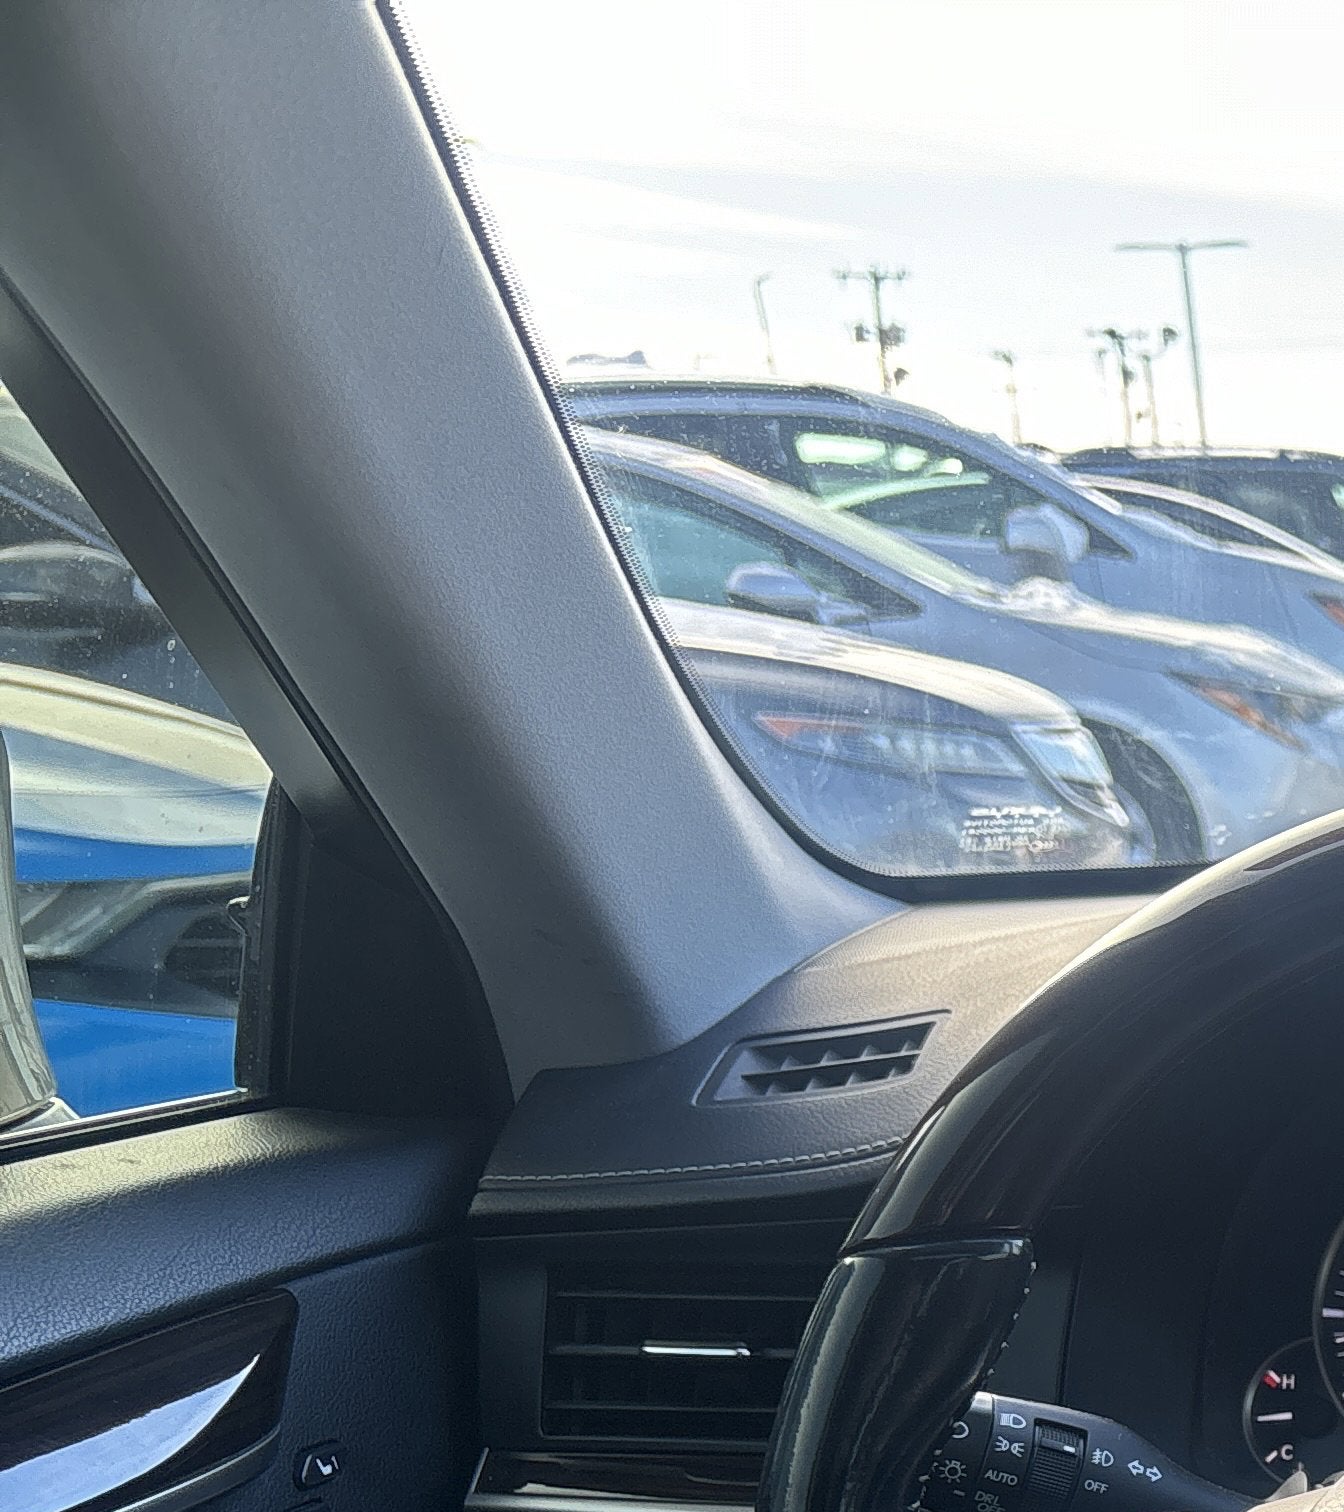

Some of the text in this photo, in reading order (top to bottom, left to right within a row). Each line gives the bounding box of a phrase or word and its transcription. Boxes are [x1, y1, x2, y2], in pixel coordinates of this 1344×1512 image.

[1281, 1374, 1296, 1390] H
[1280, 1444, 1294, 1461] C
[331, 1455, 339, 1470] 1
[984, 1468, 1018, 1486] AUTO
[1084, 1479, 1109, 1495] OFF
[974, 1490, 1002, 1508] DRL
